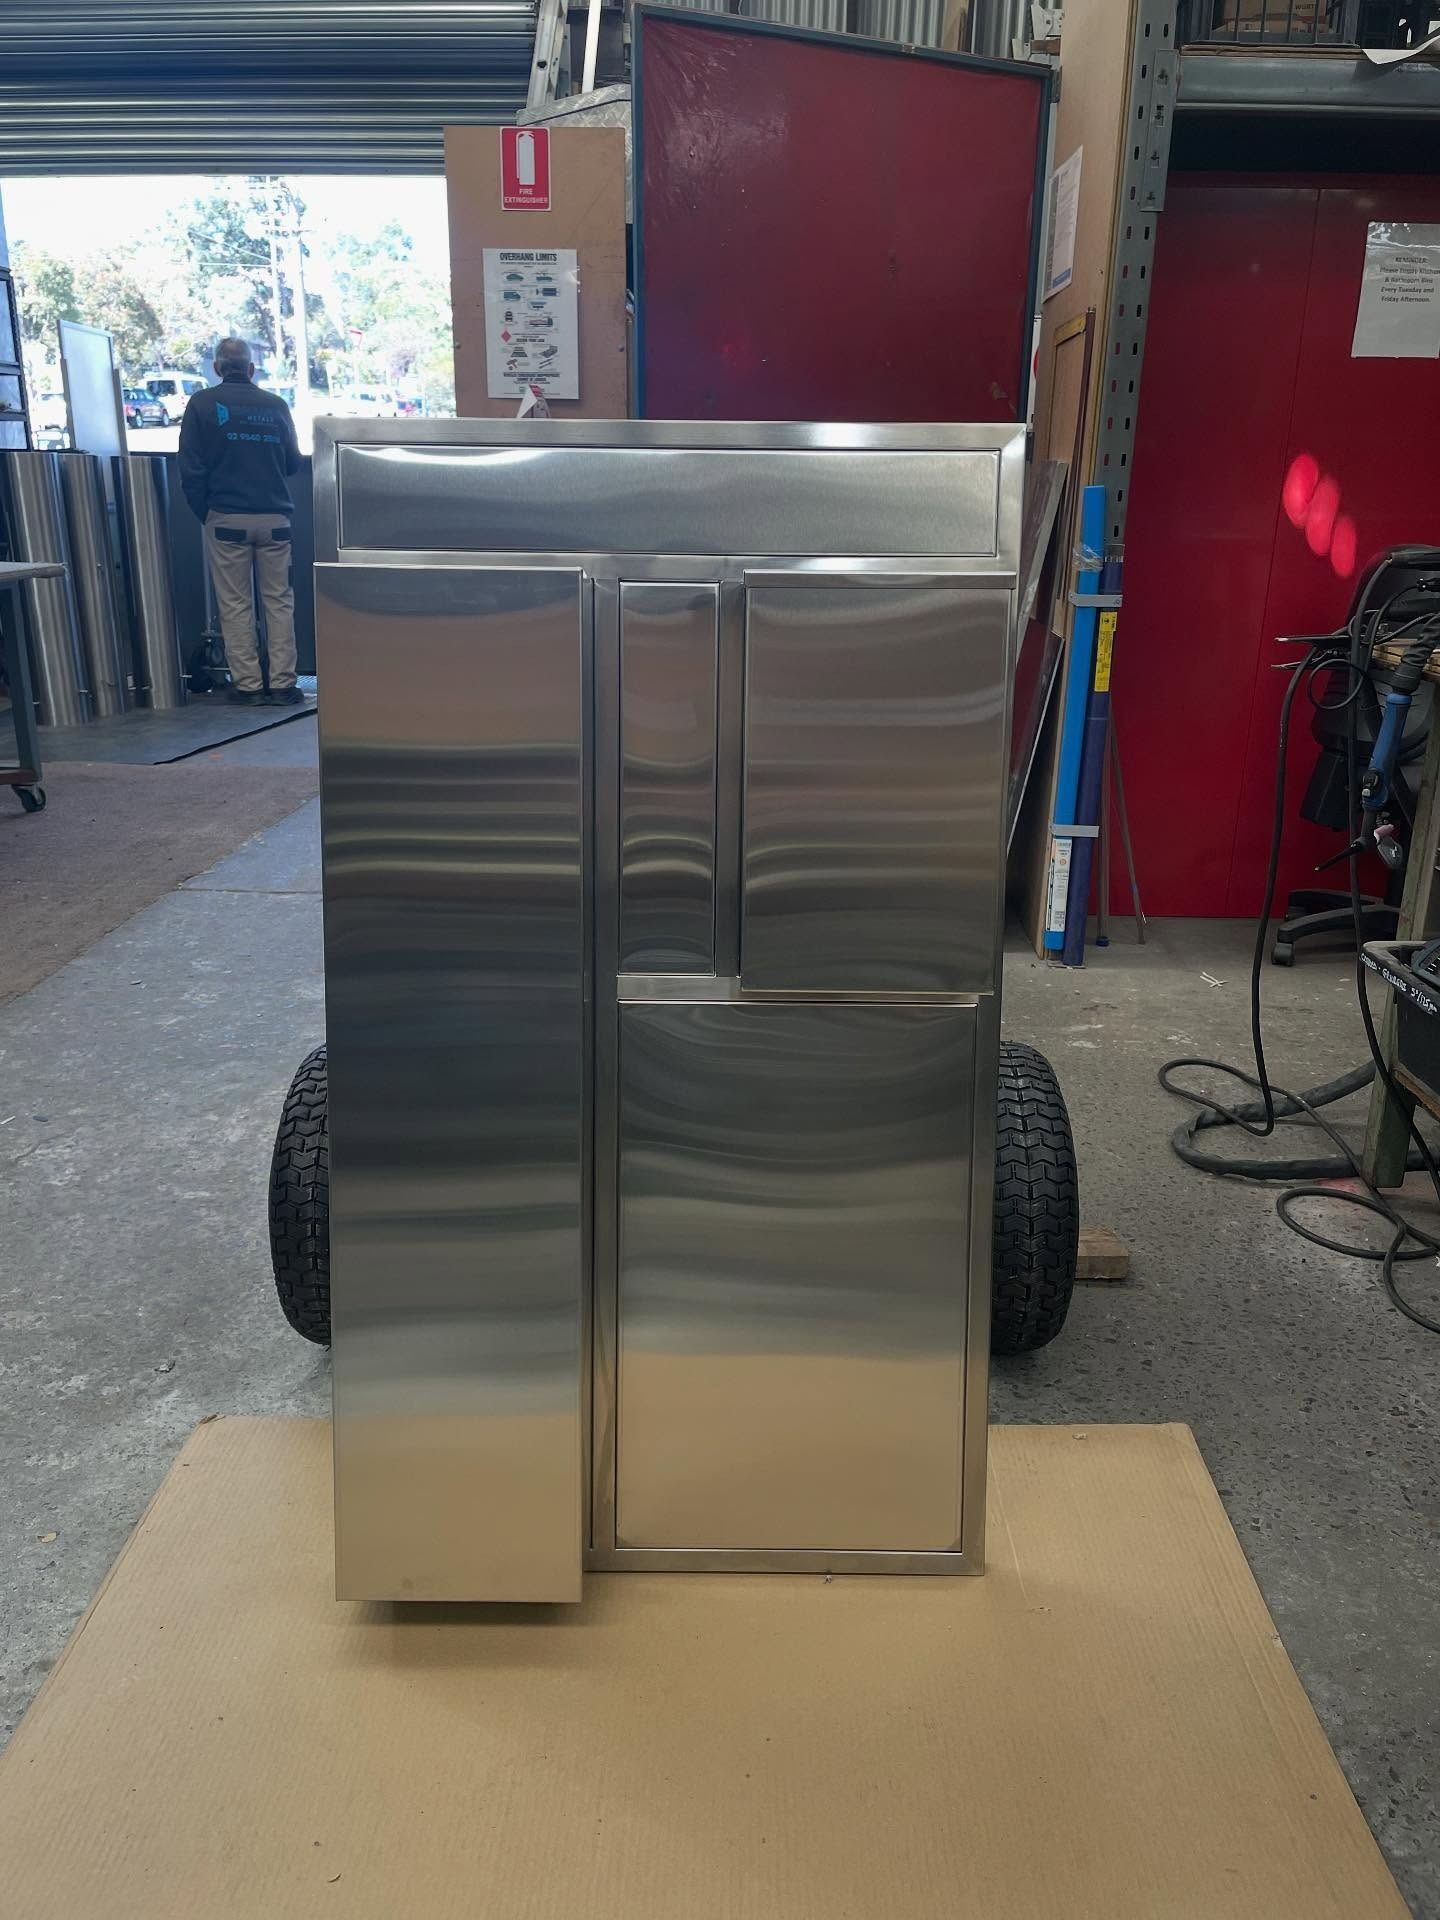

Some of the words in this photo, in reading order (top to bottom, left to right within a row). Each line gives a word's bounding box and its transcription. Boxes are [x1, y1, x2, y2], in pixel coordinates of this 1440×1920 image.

[499, 252, 534, 261] OVERHANG
[535, 253, 557, 262] LIMITS
[1398, 286, 1422, 294] Tuesday
[226, 432, 238, 440] 02
